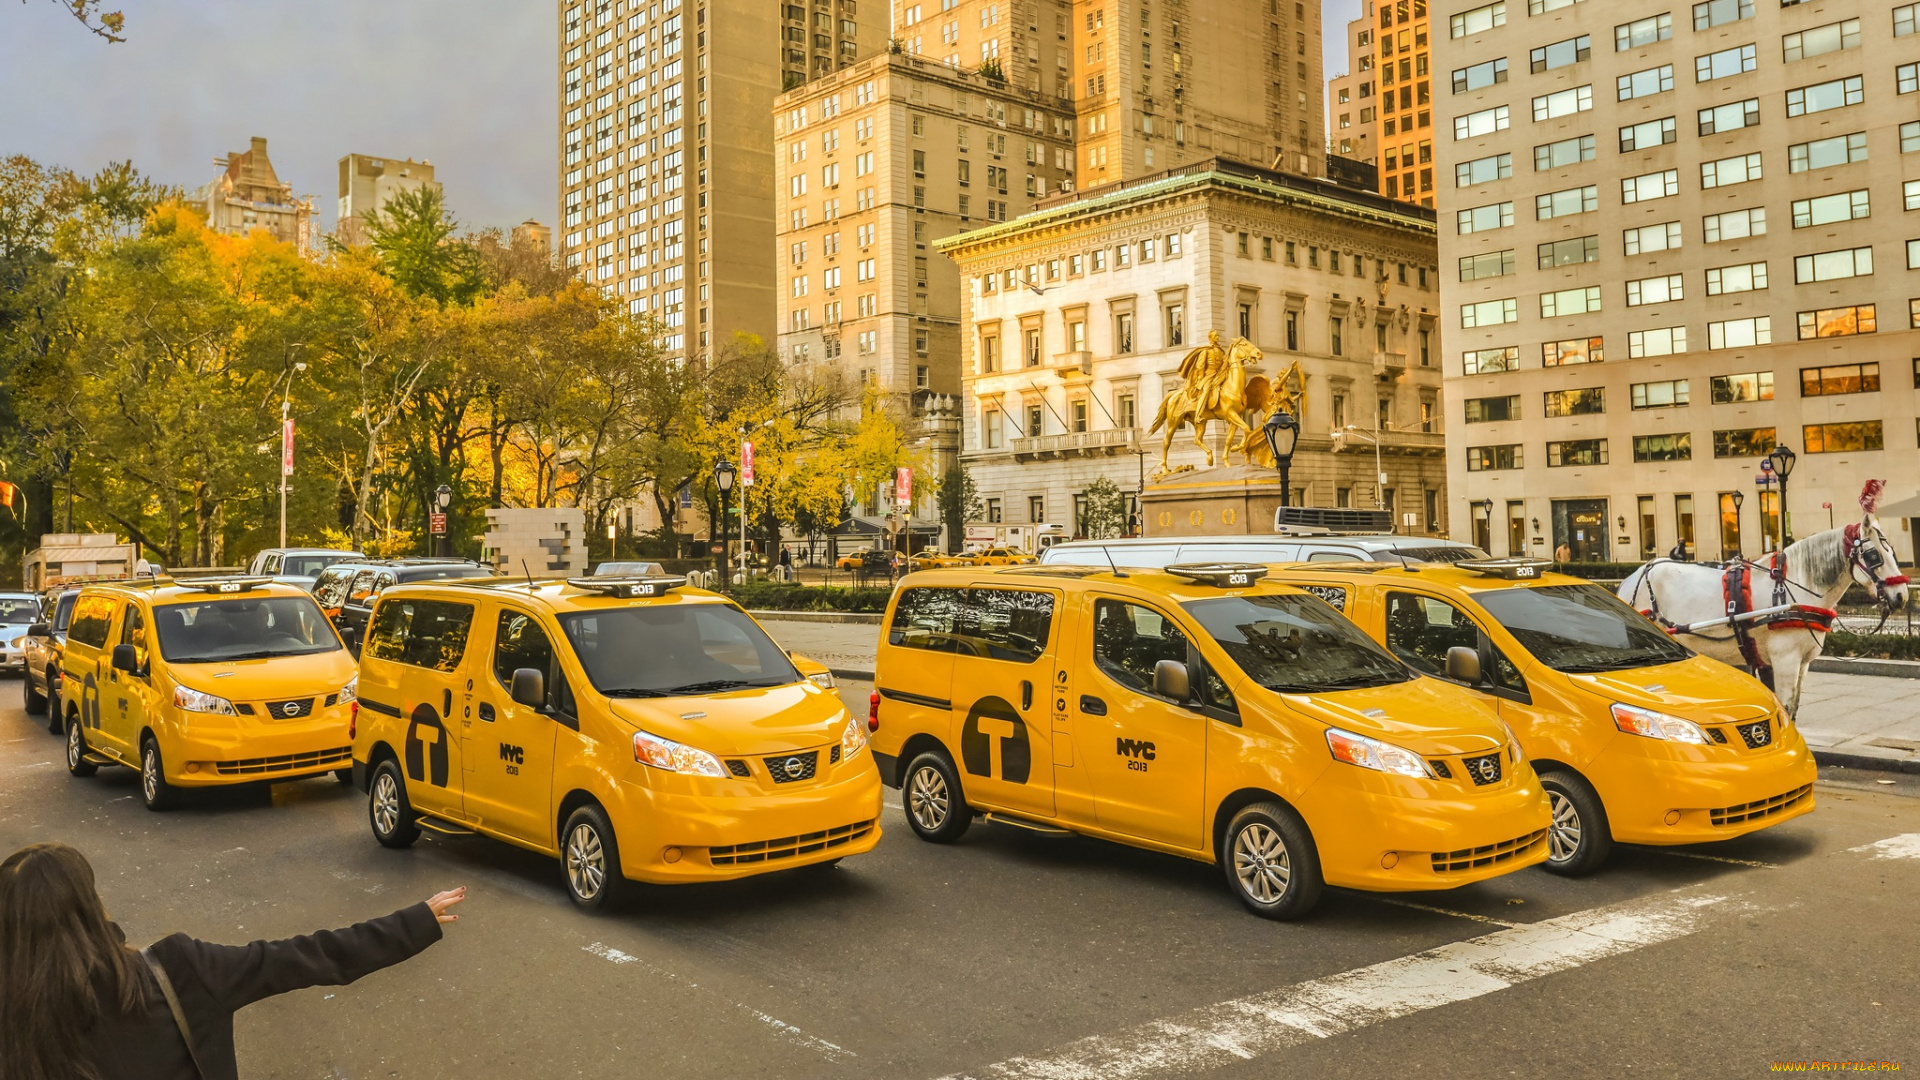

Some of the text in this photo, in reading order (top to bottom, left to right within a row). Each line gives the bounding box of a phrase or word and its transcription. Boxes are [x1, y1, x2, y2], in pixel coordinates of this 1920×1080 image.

[1516, 567, 1534, 576] 2013
[1229, 574, 1248, 584] 2013
[220, 583, 240, 592] 2013
[631, 584, 655, 595] 2013
[416, 723, 439, 784] T
[500, 742, 524, 765] NYC
[977, 716, 1014, 780] T
[1117, 737, 1156, 761] NYC
[506, 765, 519, 776] 2013
[1128, 760, 1148, 772] 2013
